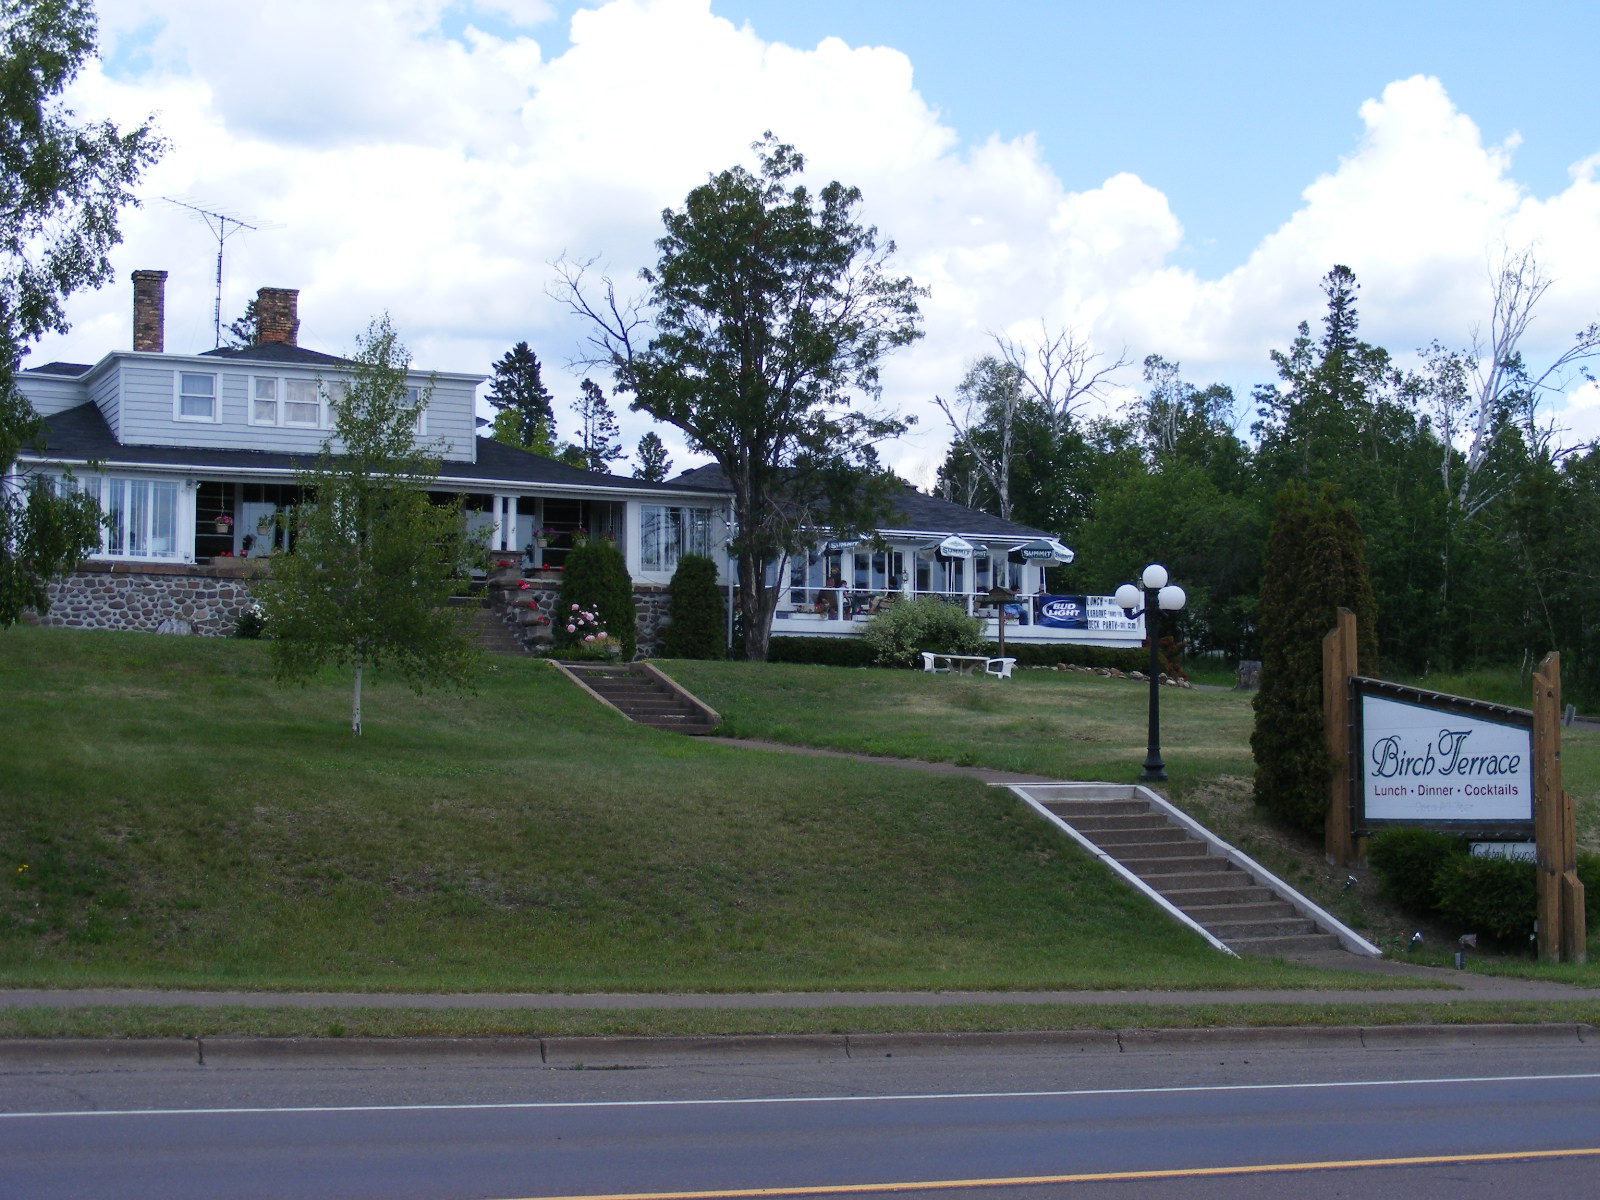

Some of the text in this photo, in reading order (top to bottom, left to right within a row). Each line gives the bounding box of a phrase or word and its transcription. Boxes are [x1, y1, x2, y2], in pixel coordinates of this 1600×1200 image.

[830, 541, 859, 549] SUMMIT
[942, 547, 971, 556] SUMMIT
[1023, 550, 1052, 558] SUMMIT
[1053, 602, 1077, 610] BUD
[1048, 609, 1081, 617] LIGHT
[1088, 619, 1100, 629] DECK
[1371, 729, 1521, 778] Birch Terrace
[1374, 784, 1518, 796] Lunch Dinner Cocktails
